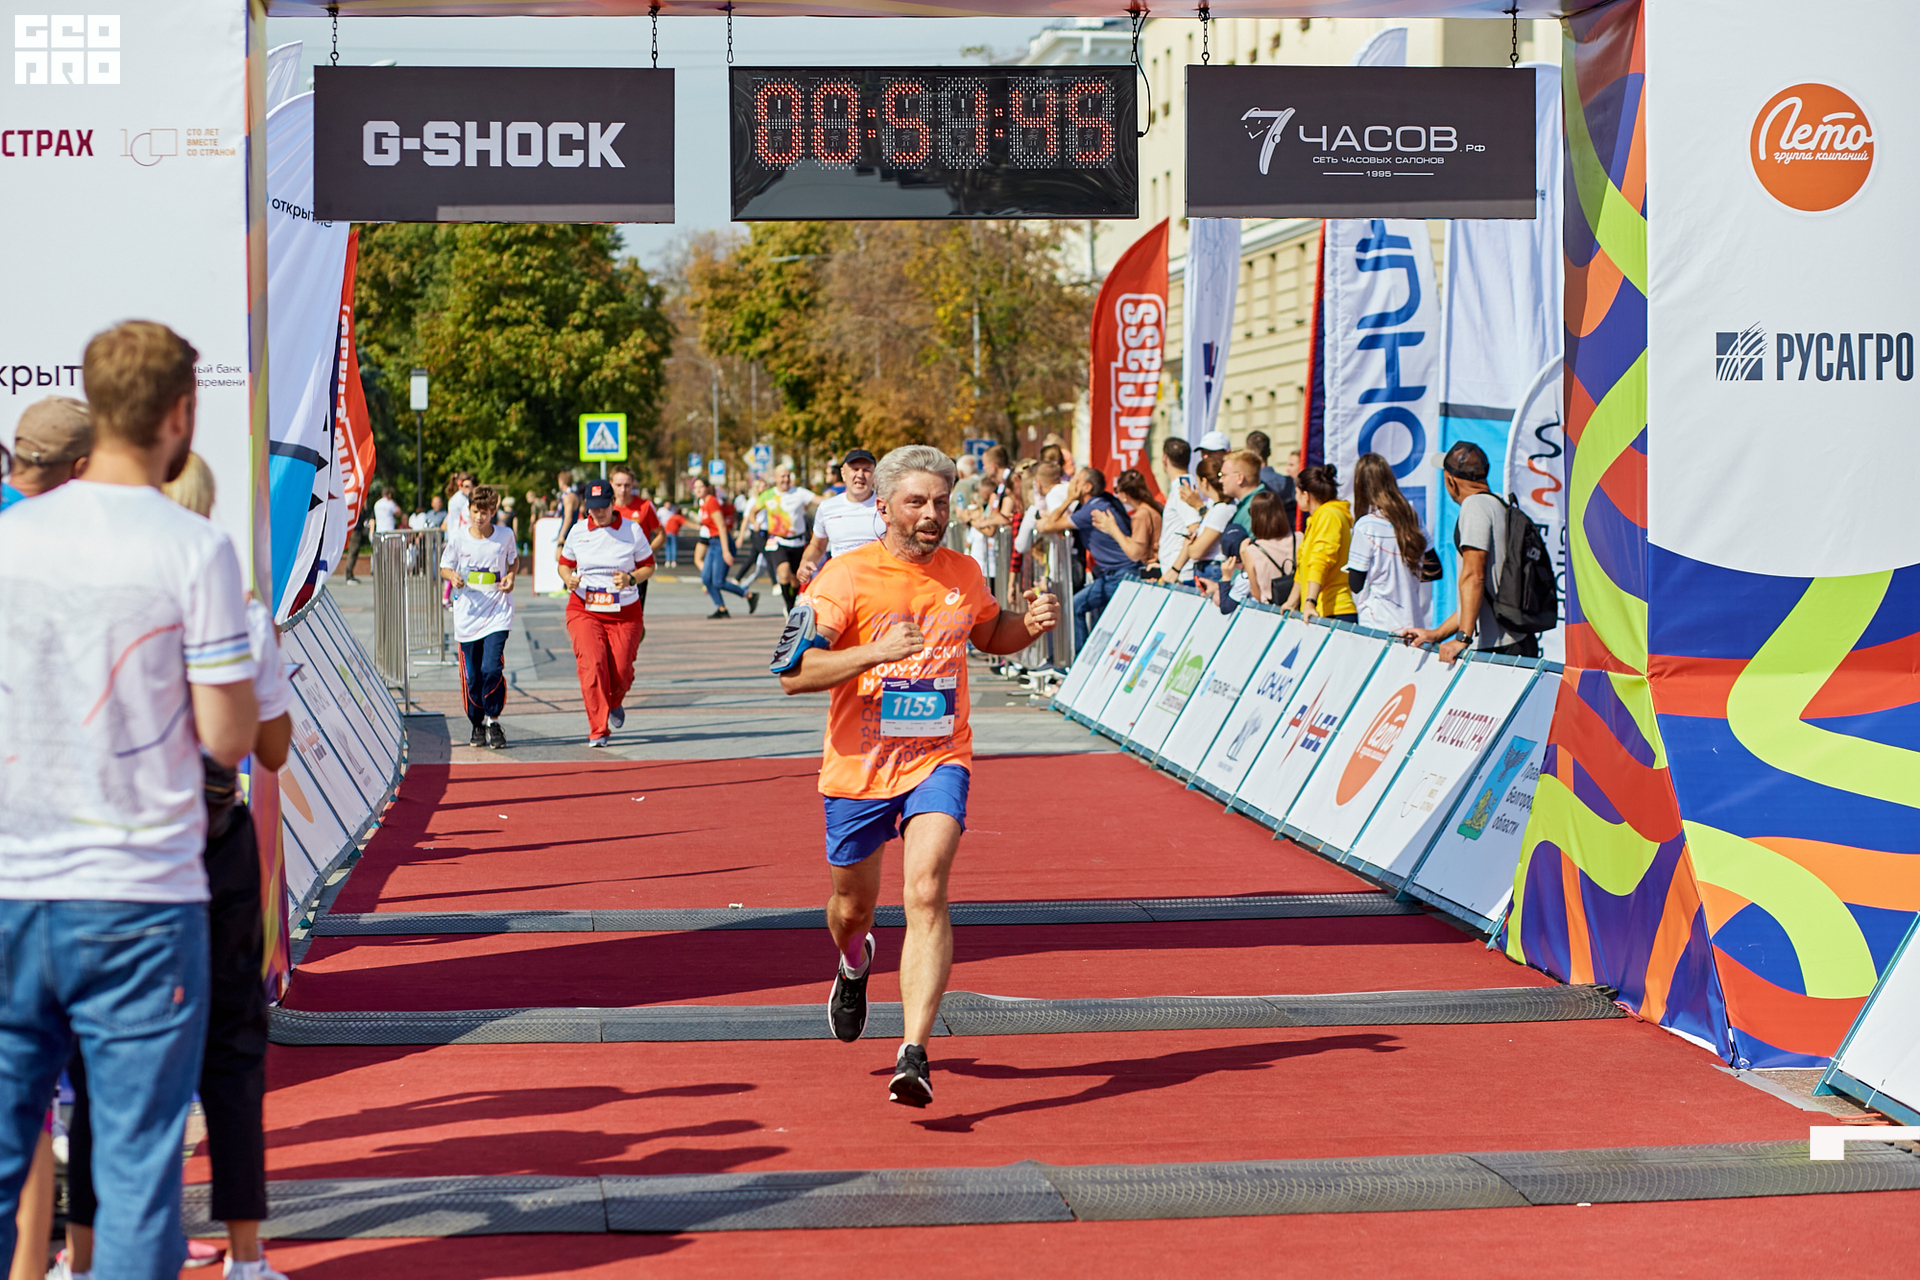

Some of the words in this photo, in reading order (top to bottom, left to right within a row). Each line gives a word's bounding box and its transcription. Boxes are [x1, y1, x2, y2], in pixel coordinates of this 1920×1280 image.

[186, 128, 202, 136] СТО
[204, 128, 219, 136] ЛЕТ
[186, 138, 218, 146] ВМЕСТЕ
[1298, 124, 1458, 153] ЧАСОВ
[362, 120, 626, 168] G-SHOCK
[186, 148, 198, 156] СО
[199, 147, 236, 156] СТРАНОЙ
[1312, 156, 1339, 164] СЕТЬ
[1341, 156, 1393, 164] ЧАСОВЫХ
[1395, 157, 1445, 165] САЛОНОВ
[1773, 151, 1814, 165] группа
[1366, 170, 1392, 178] 1995
[1776, 332, 1914, 382] РУСАГРО
[216, 363, 242, 374] банк
[197, 379, 246, 389] времени
[893, 696, 938, 717] 1155
